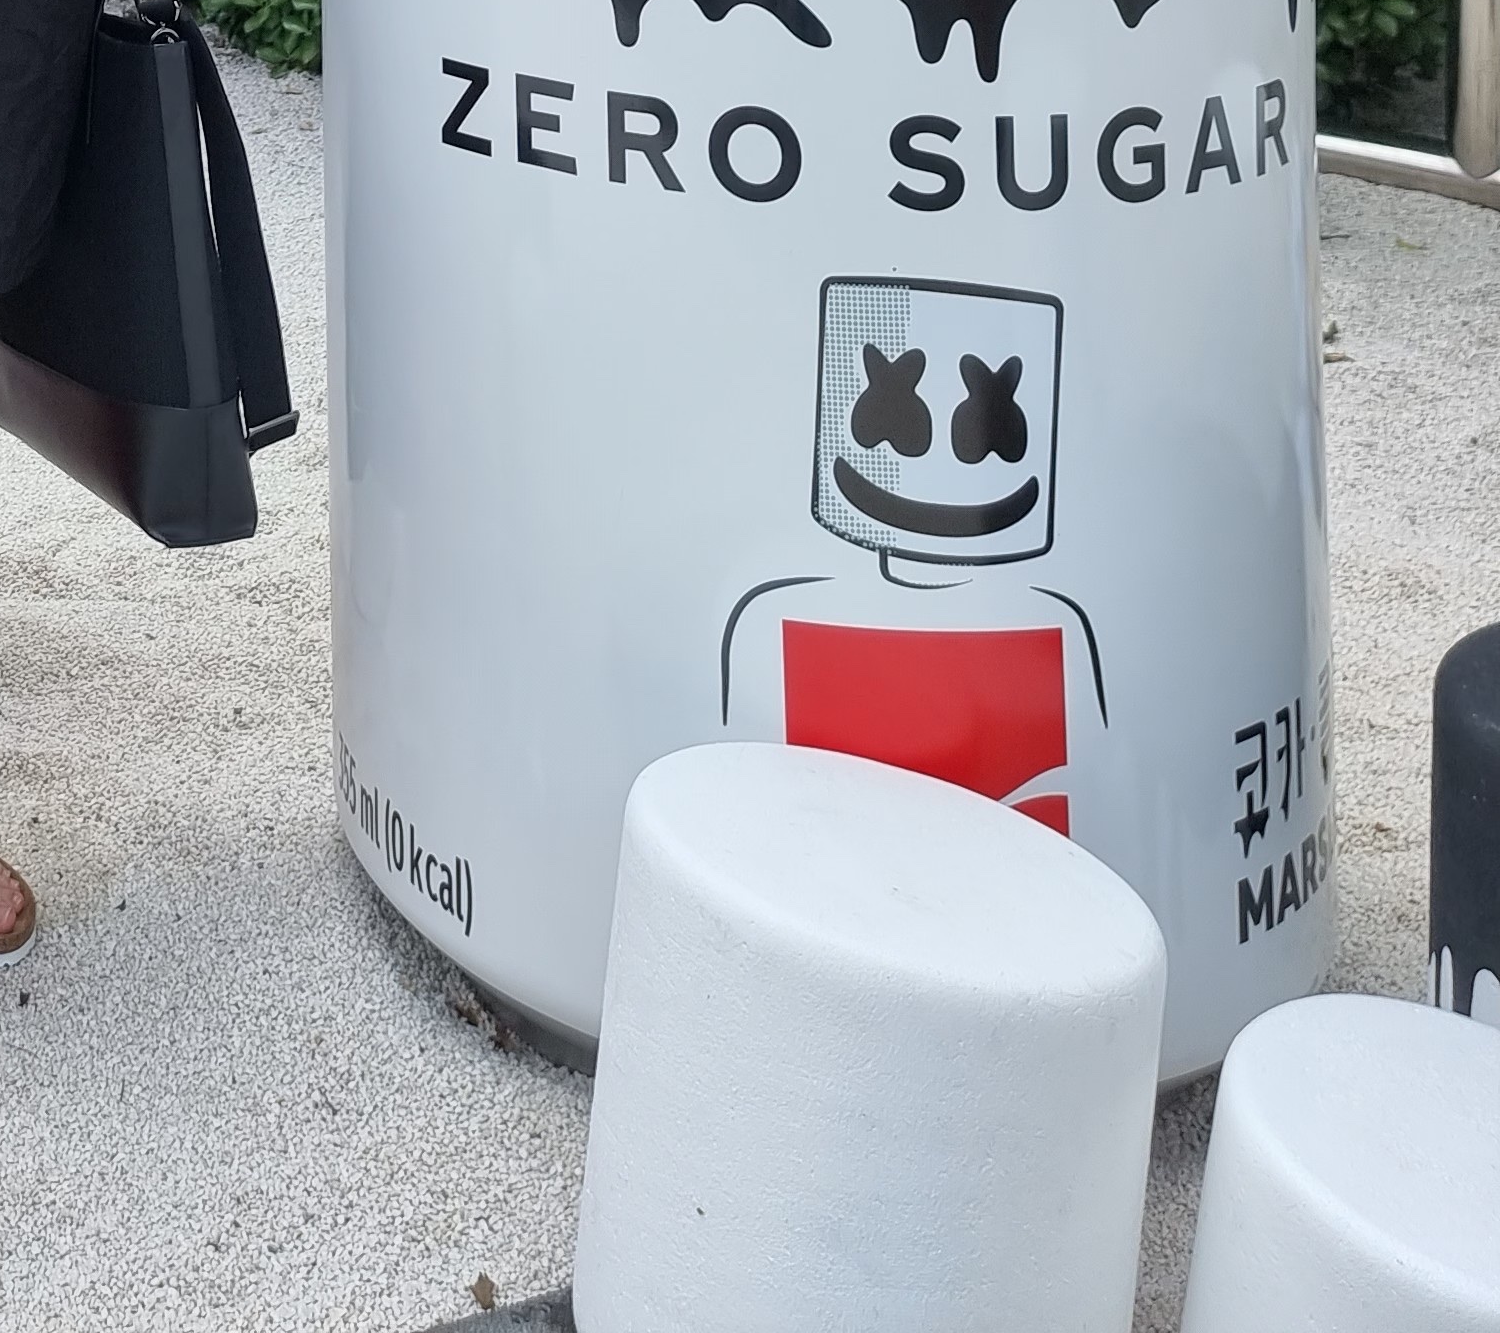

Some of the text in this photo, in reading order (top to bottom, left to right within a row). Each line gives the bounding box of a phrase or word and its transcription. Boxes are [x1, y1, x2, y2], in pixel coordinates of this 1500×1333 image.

[441, 56, 1289, 211] ZERO SUGAR
[360, 783, 381, 850] ml
[385, 797, 404, 874] (0
[409, 822, 474, 937] kcal)
